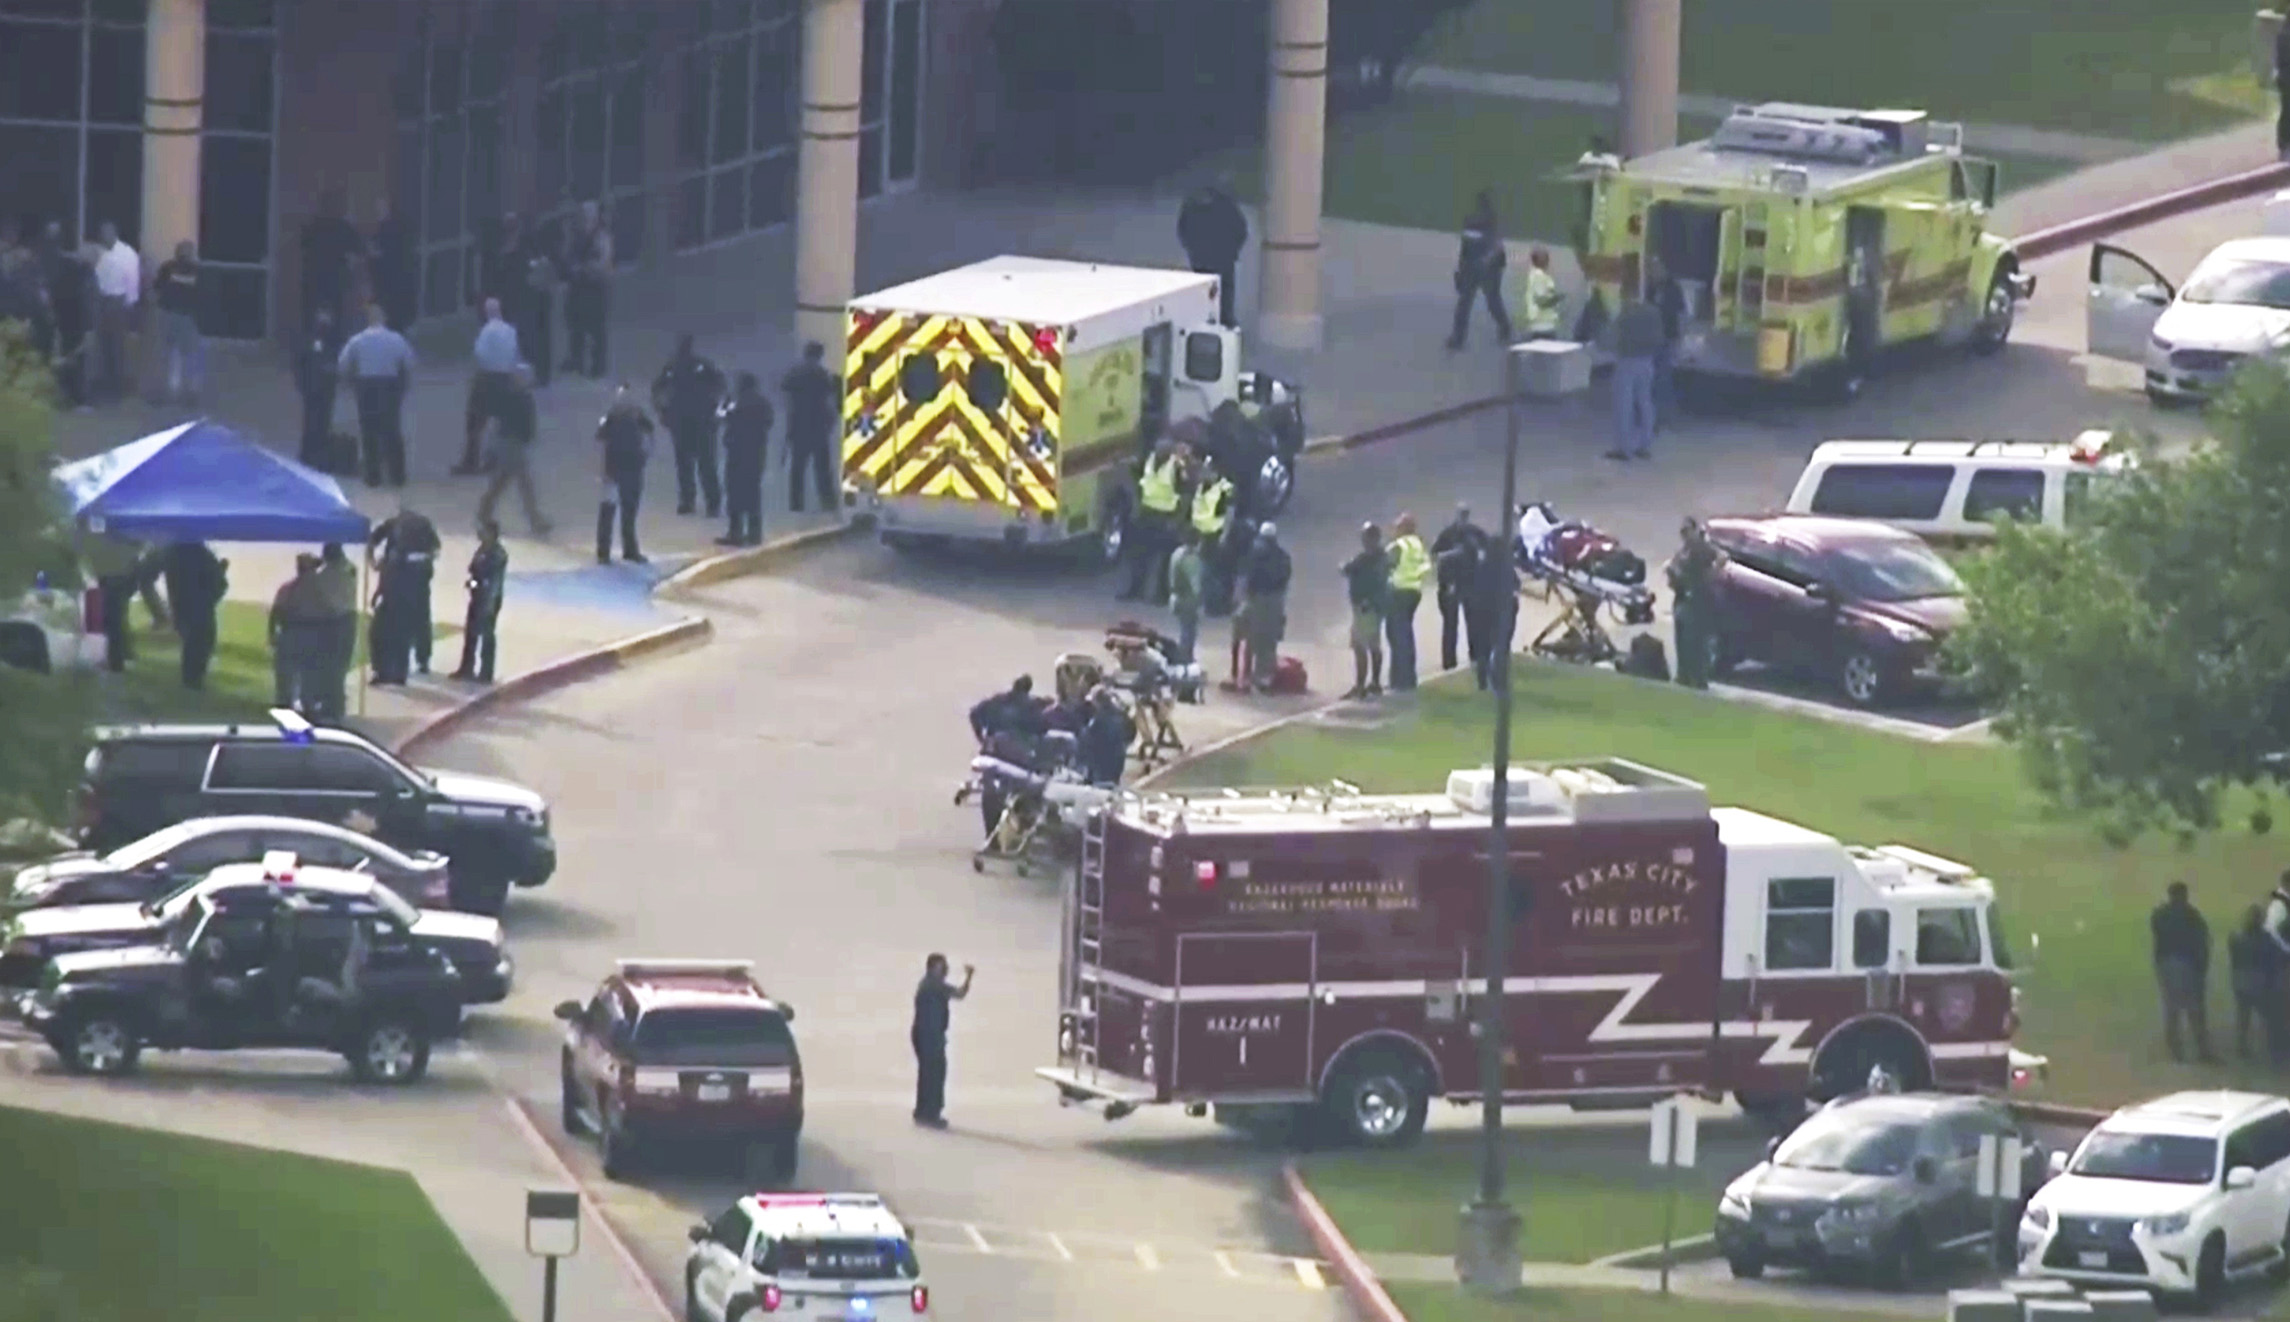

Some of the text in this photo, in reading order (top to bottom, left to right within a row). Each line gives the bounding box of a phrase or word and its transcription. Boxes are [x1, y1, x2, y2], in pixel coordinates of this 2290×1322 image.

[1560, 863, 1698, 896] TEXAS CITY
[1572, 904, 1688, 926] FIRE DEPT.
